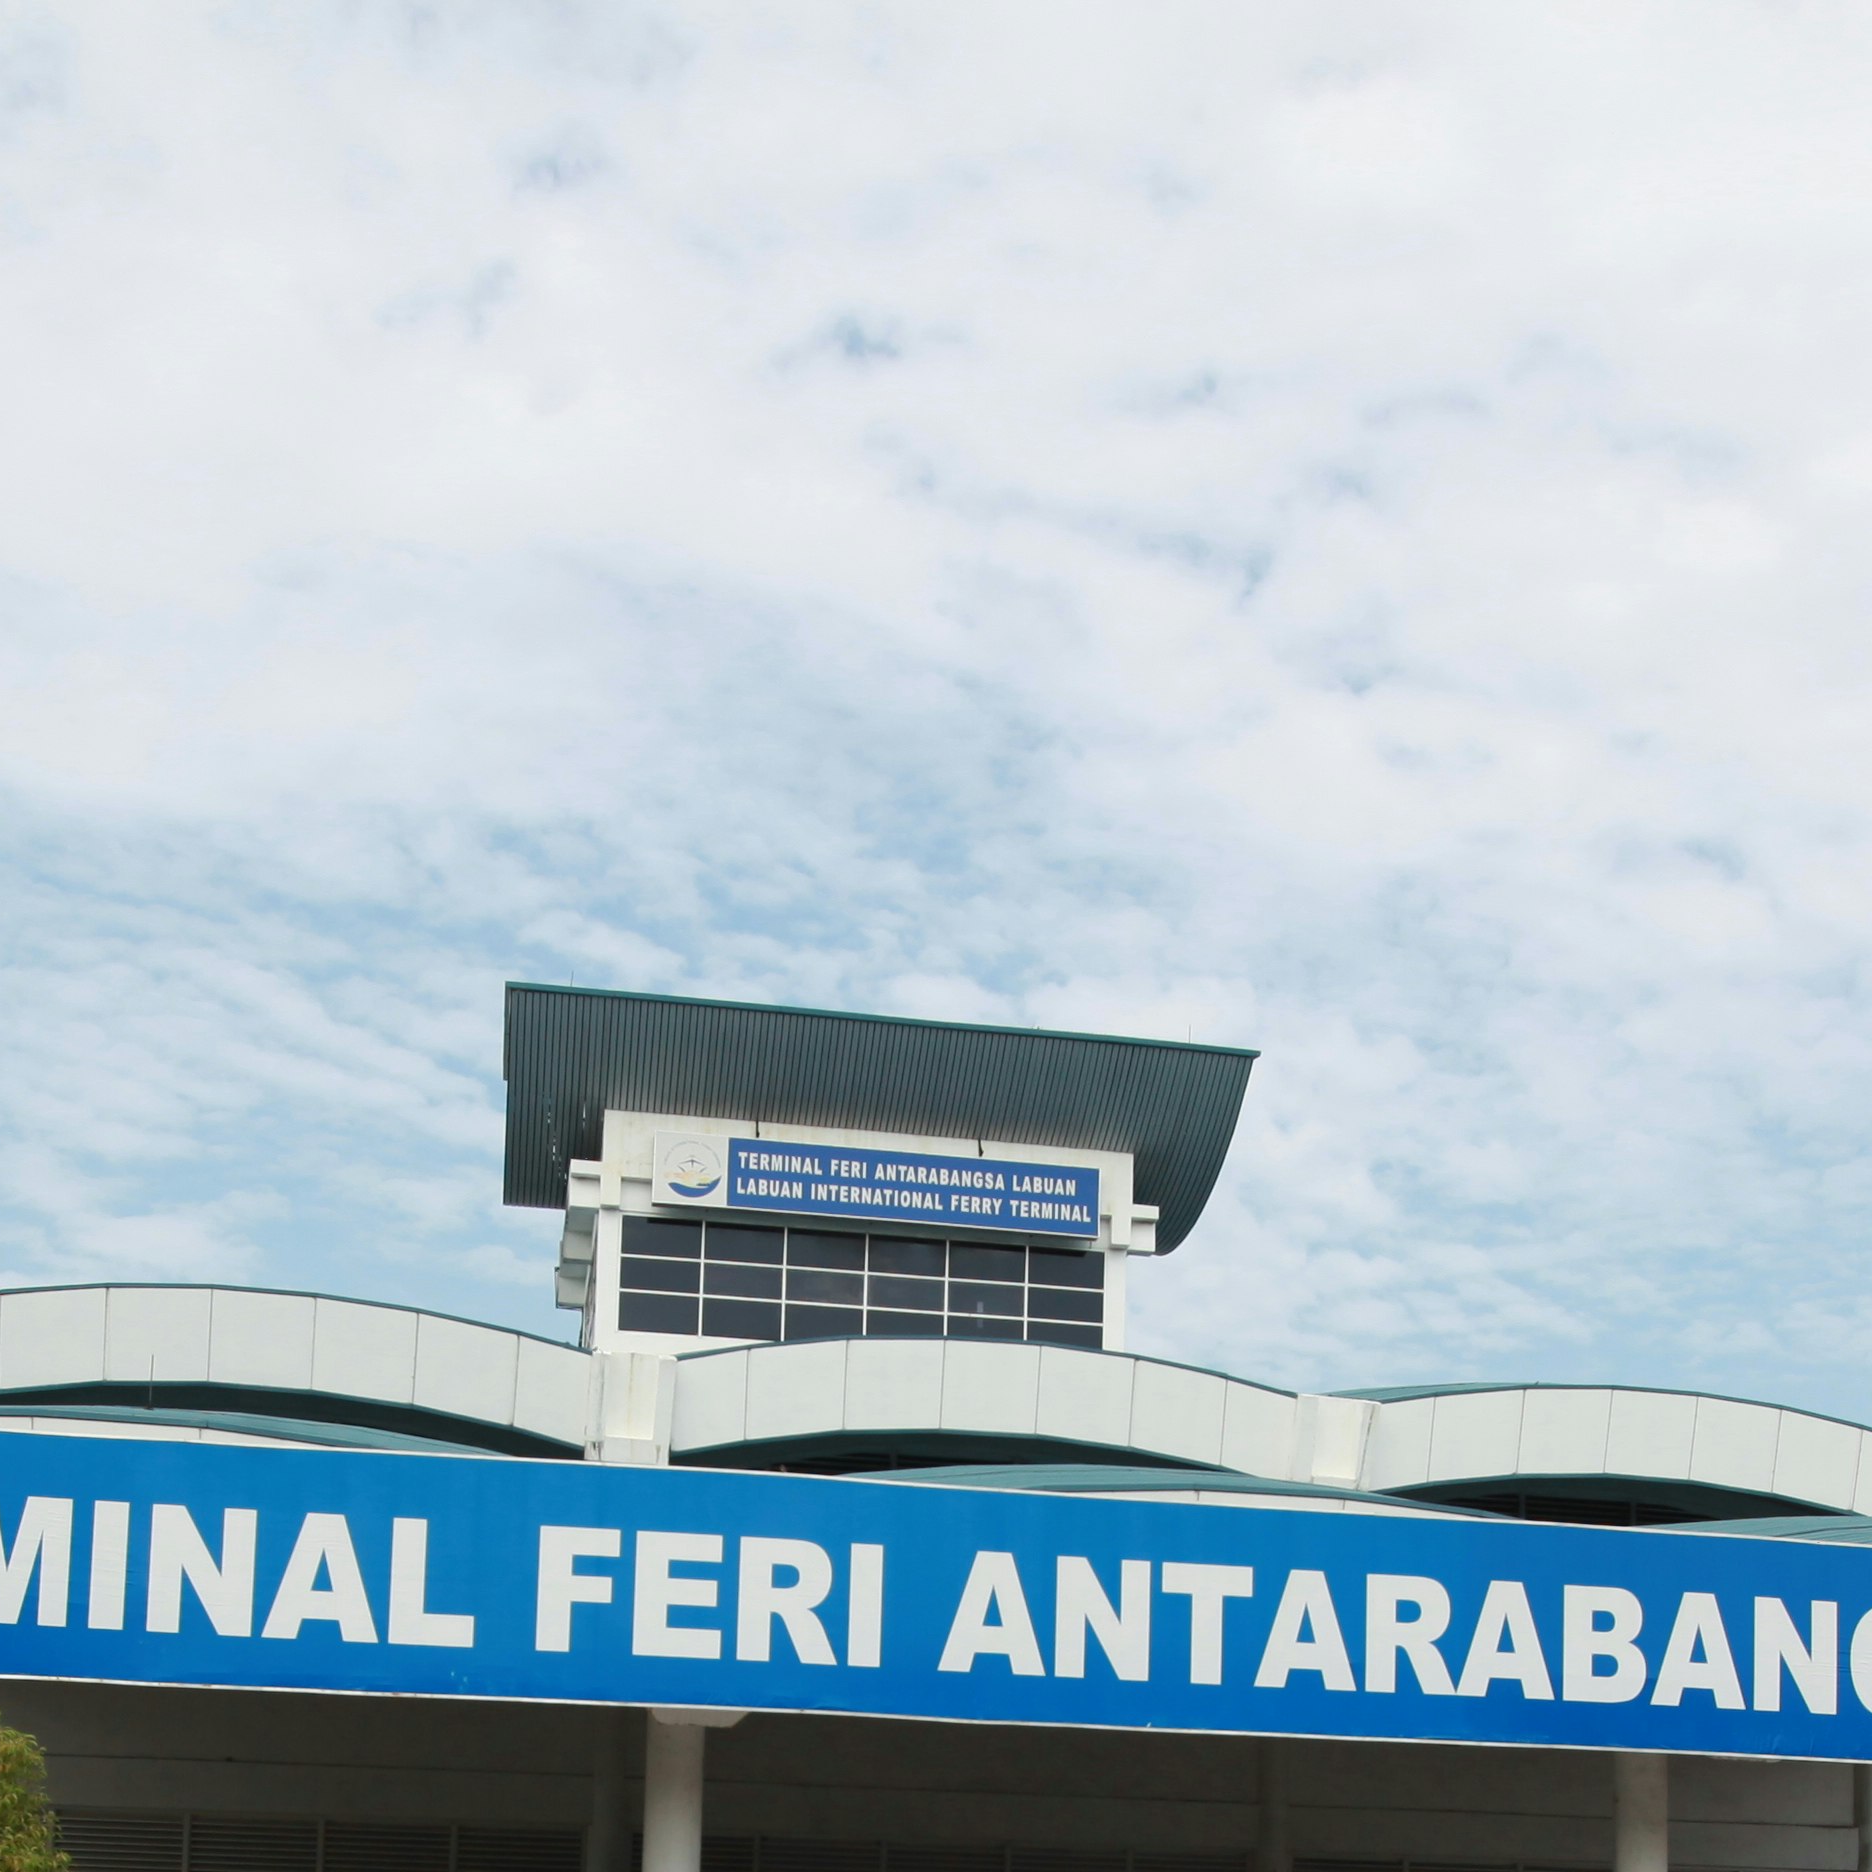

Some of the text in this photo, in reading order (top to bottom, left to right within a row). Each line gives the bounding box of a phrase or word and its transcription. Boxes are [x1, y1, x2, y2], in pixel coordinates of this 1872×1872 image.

[738, 1152, 823, 1176] TERMINAL
[831, 1158, 867, 1179] FERI
[874, 1163, 1005, 1191] ANTARABANGSA
[1012, 1175, 1076, 1197] LABUAN
[736, 1177, 1091, 1223] LABUAN INTERNATIONAL FERRY TERMINAL
[534, 1525, 885, 1668] FERI
